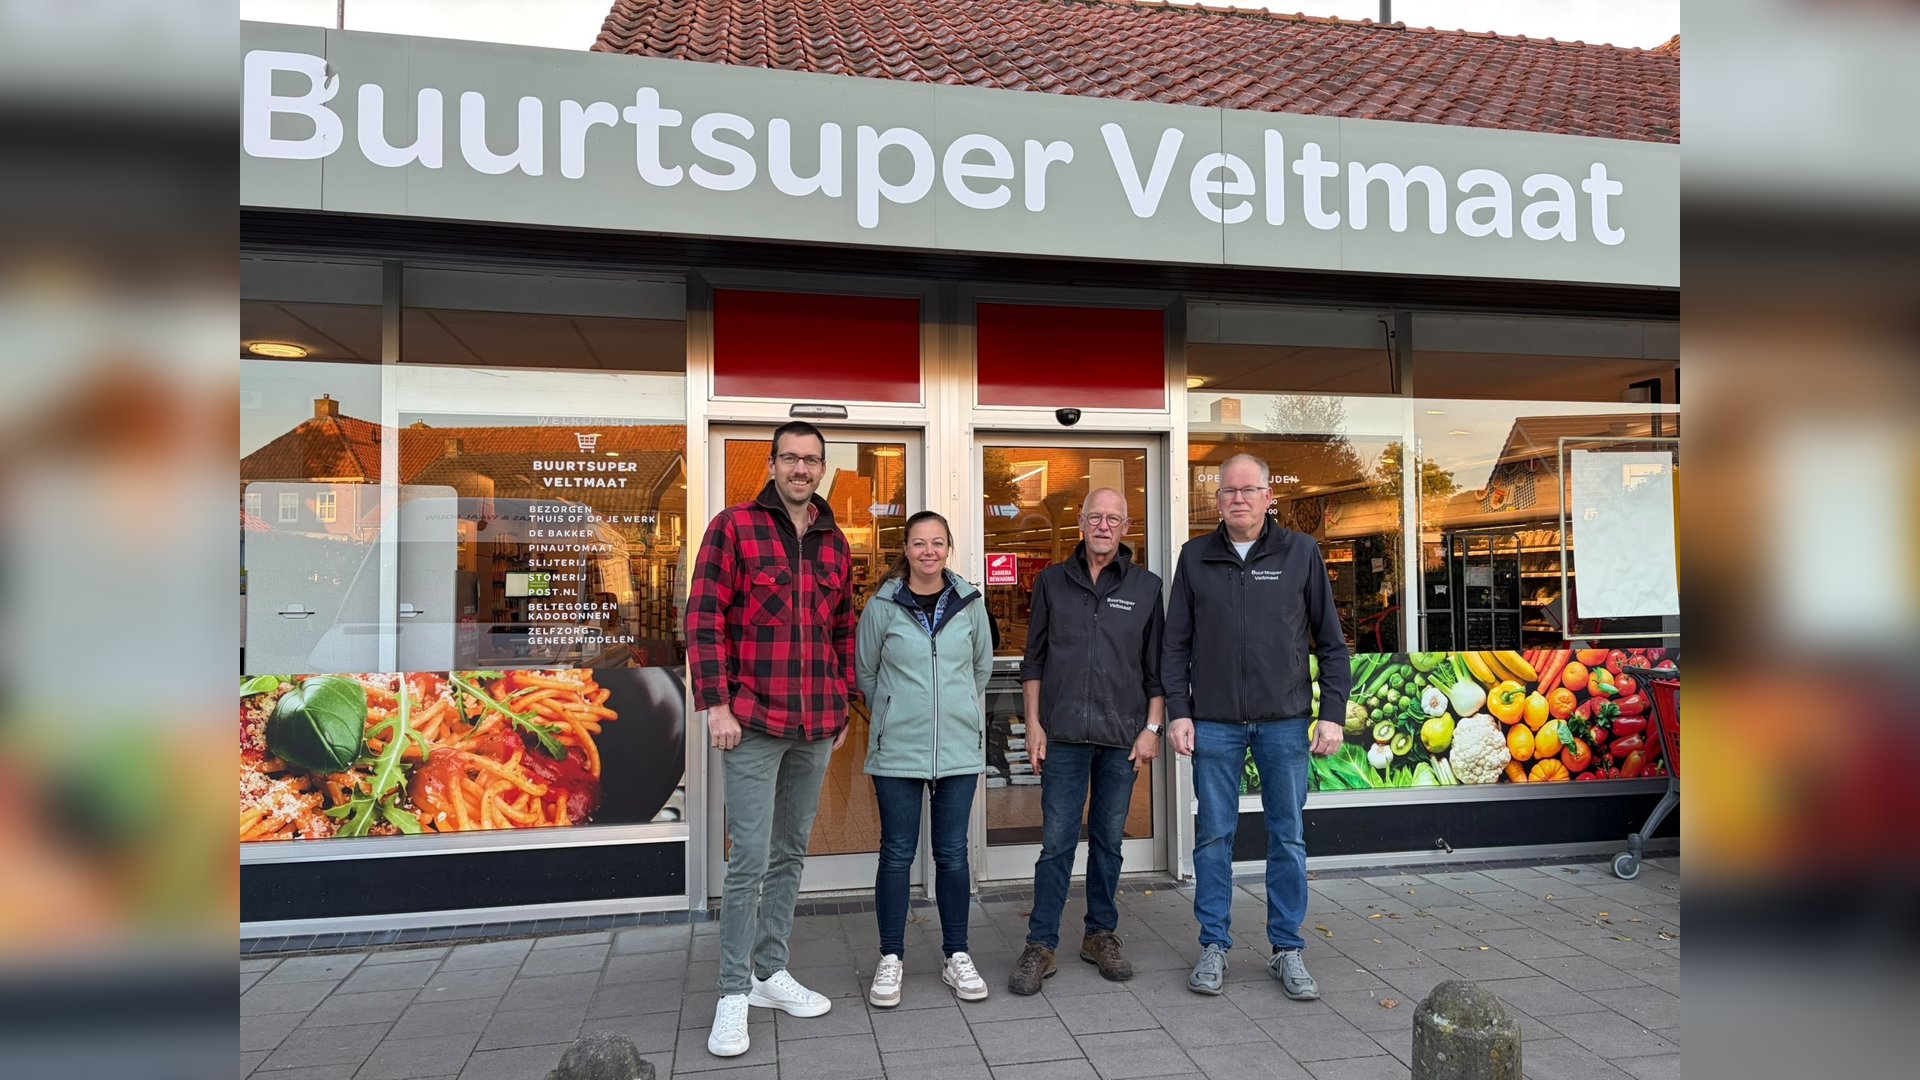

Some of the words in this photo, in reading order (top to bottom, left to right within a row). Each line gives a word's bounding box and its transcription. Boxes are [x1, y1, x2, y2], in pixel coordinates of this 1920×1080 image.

[242, 49, 1074, 229] Buurtsuper
[1100, 122, 1626, 246] Veltmaat
[536, 416, 605, 426] WELKOM
[611, 418, 635, 427] BIJ
[532, 460, 637, 472] BUURTSUPER
[543, 477, 627, 488] VELTMAAT
[529, 505, 592, 514] BEZORGEN
[529, 515, 564, 523] THUIS
[568, 515, 583, 523] OF
[587, 515, 602, 523] OP
[607, 515, 619, 523] JE
[623, 515, 656, 523] WERK
[528, 529, 544, 538] DE
[548, 529, 593, 538] BAKKER
[528, 544, 613, 552] PINAUTOMAAT
[528, 559, 586, 567] SLIJTERIJ
[528, 573, 587, 582] STOMERIJ
[528, 588, 577, 596] POST.NL
[528, 603, 598, 611] BELTEGOED
[602, 602, 617, 610] EN
[528, 612, 610, 620] KADOBONNEN
[528, 627, 594, 635] ZELFZORG-
[528, 635, 635, 645] GENEESMIDDELEN
